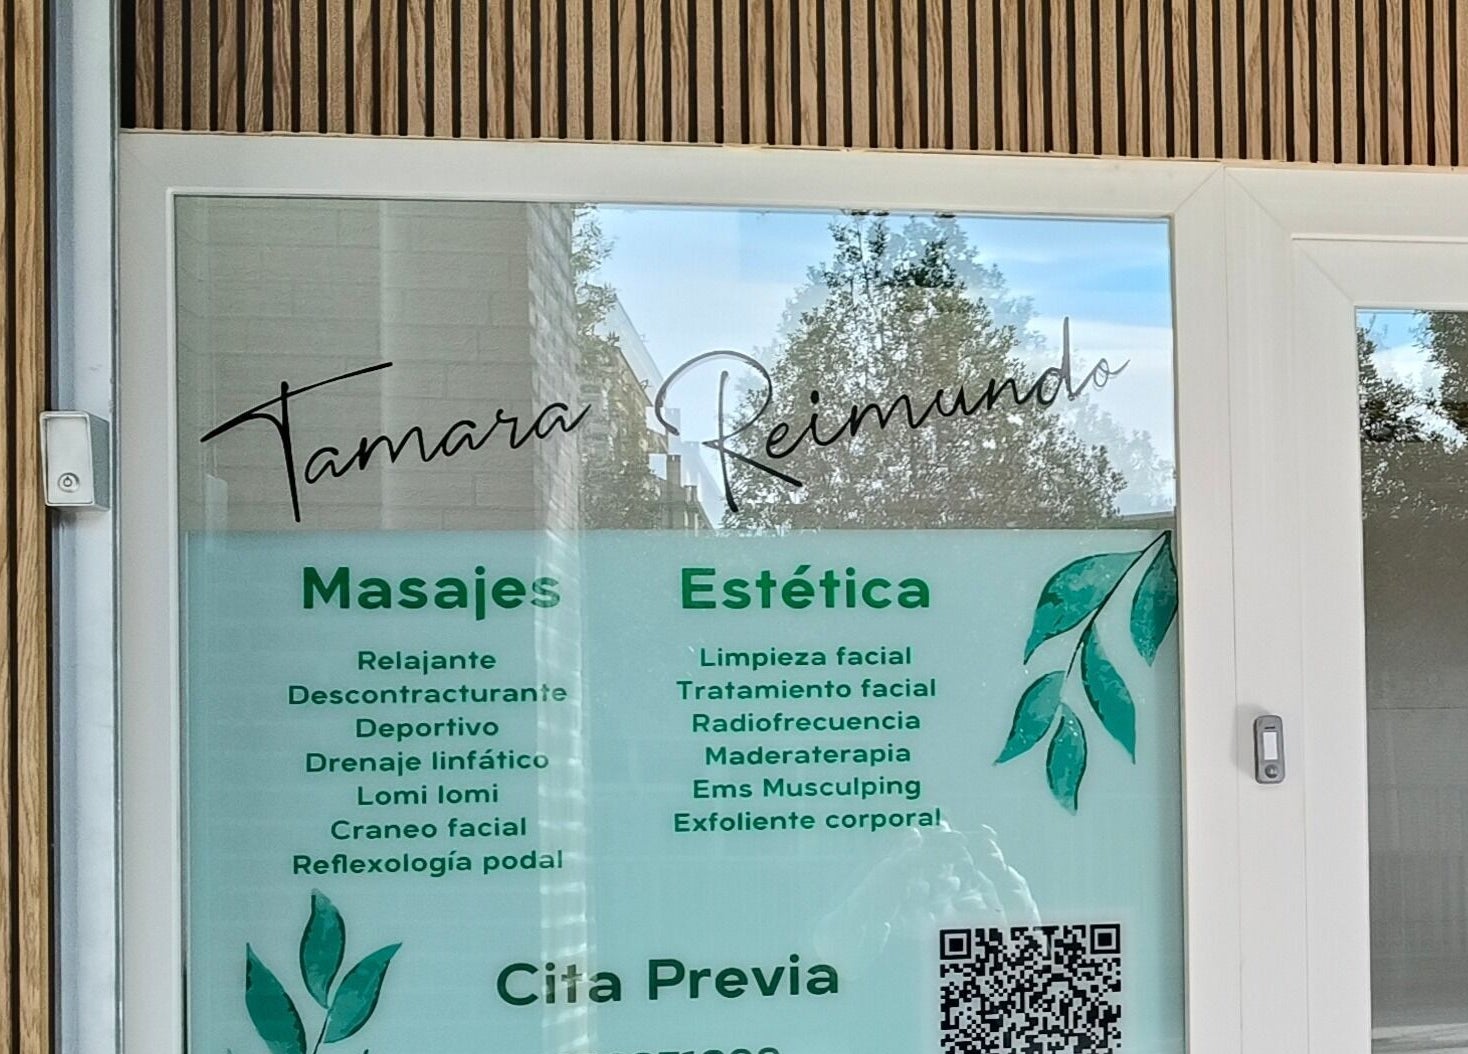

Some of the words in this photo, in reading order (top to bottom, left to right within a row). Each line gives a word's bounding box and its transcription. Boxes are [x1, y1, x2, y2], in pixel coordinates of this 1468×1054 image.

[200, 361, 592, 523] Tamara
[654, 316, 1131, 513] Reimundo
[302, 565, 561, 621] Masajes
[681, 564, 931, 610] Estética
[357, 649, 497, 676] Relajante
[700, 646, 827, 671] Limpieza
[835, 645, 912, 666] facial
[288, 683, 569, 705] Descontracturante
[675, 679, 852, 701] Tratamiento
[860, 677, 936, 698] facial
[355, 716, 500, 743] Deportivo
[692, 710, 921, 734] Radiofrecuencia
[305, 751, 422, 777] Drenaje
[432, 748, 550, 771] linfático
[705, 742, 911, 768] Maderaterapia
[357, 785, 428, 806] Lomi
[437, 782, 499, 805] lomi
[692, 778, 753, 800] Ems
[762, 775, 922, 801] Musculping
[330, 819, 438, 841] Craneo
[447, 816, 527, 838] facial
[673, 810, 817, 833] Exfoliente
[825, 807, 941, 833] corporal
[292, 850, 473, 878] Reflexología
[483, 849, 563, 876] podal
[496, 961, 622, 1007] Cita
[648, 953, 839, 1001] Previa
